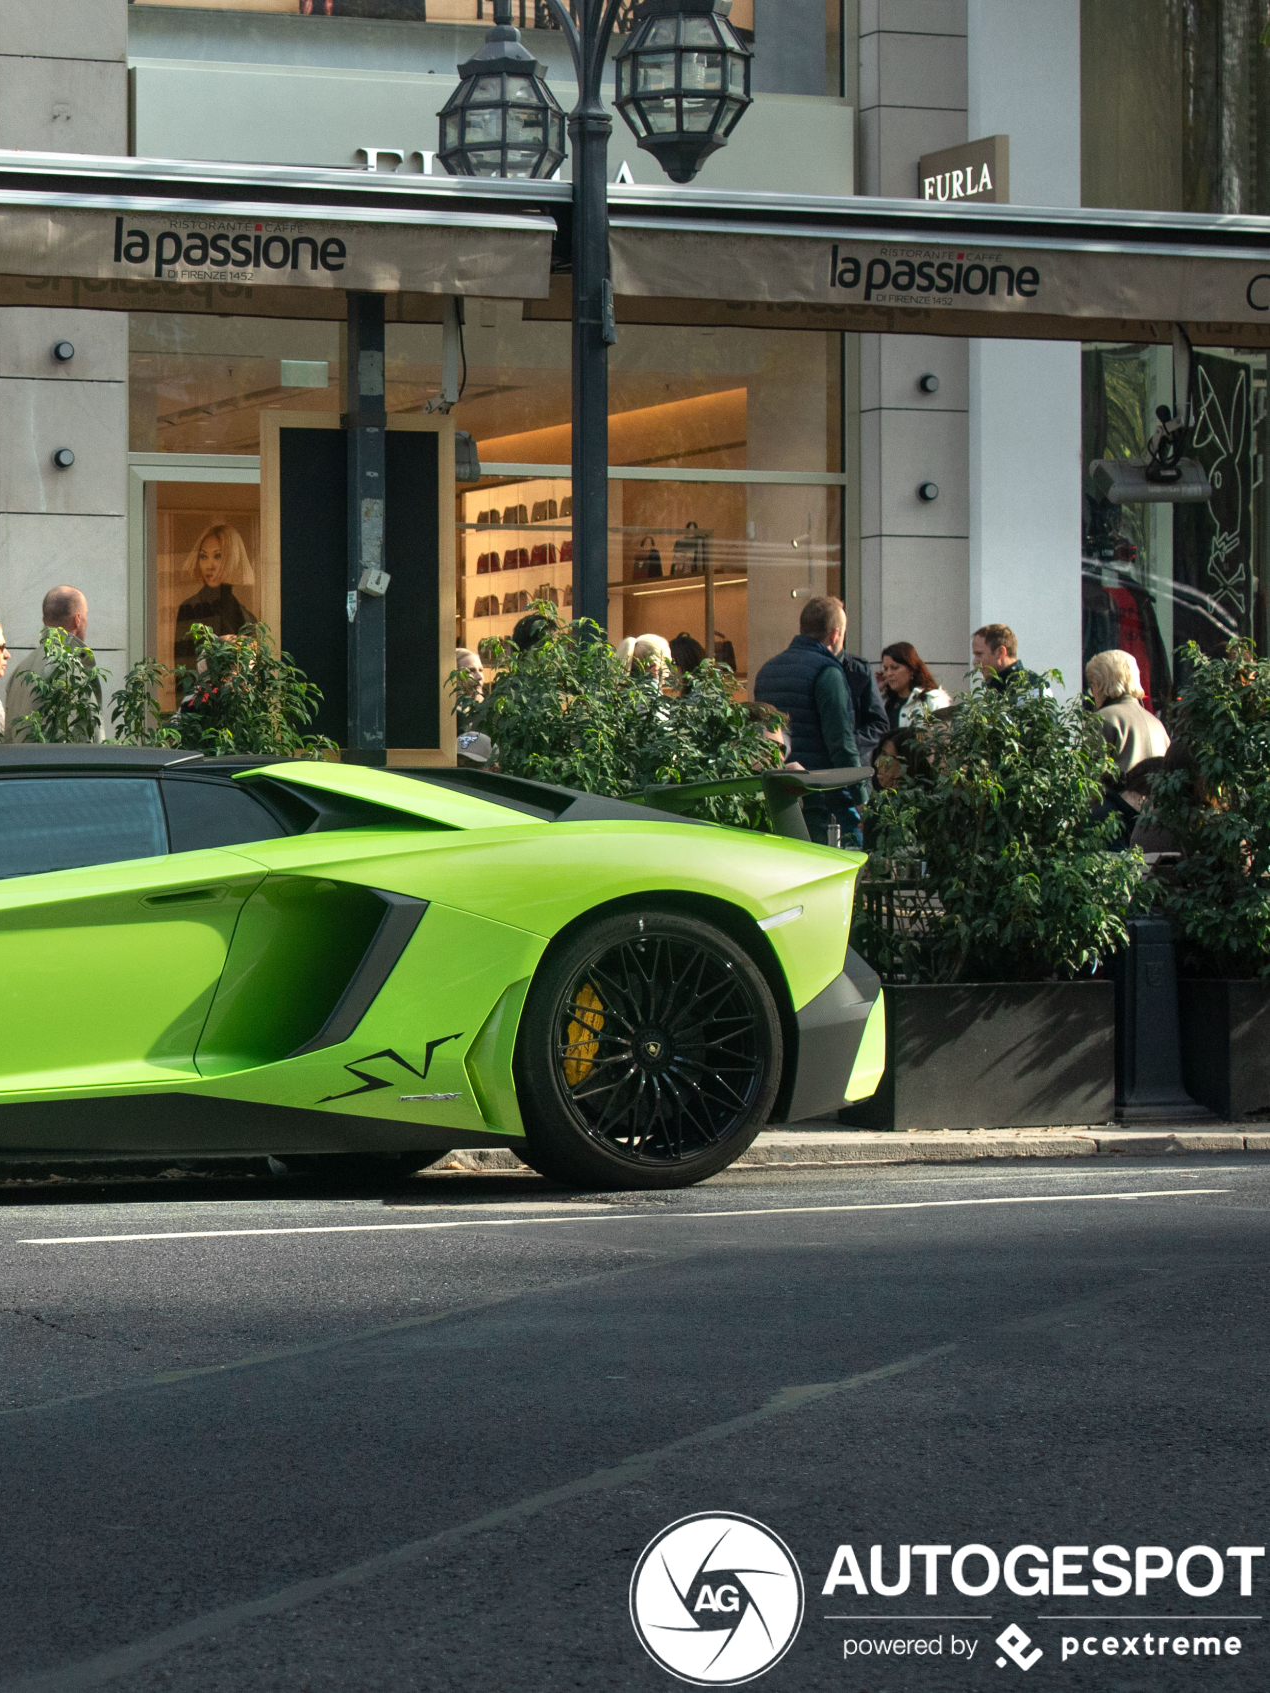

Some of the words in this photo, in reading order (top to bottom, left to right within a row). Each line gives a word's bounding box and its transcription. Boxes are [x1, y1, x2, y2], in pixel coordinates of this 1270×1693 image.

[924, 162, 993, 202] FURLA
[170, 220, 254, 232] RISTORANTE
[880, 248, 954, 260] RISTORANTE
[167, 270, 178, 279] DI
[181, 270, 226, 280] FIRENZE
[230, 272, 254, 282] 1452
[876, 294, 887, 303] DI
[888, 294, 930, 305] FIRENZE
[933, 296, 953, 306] 1452
